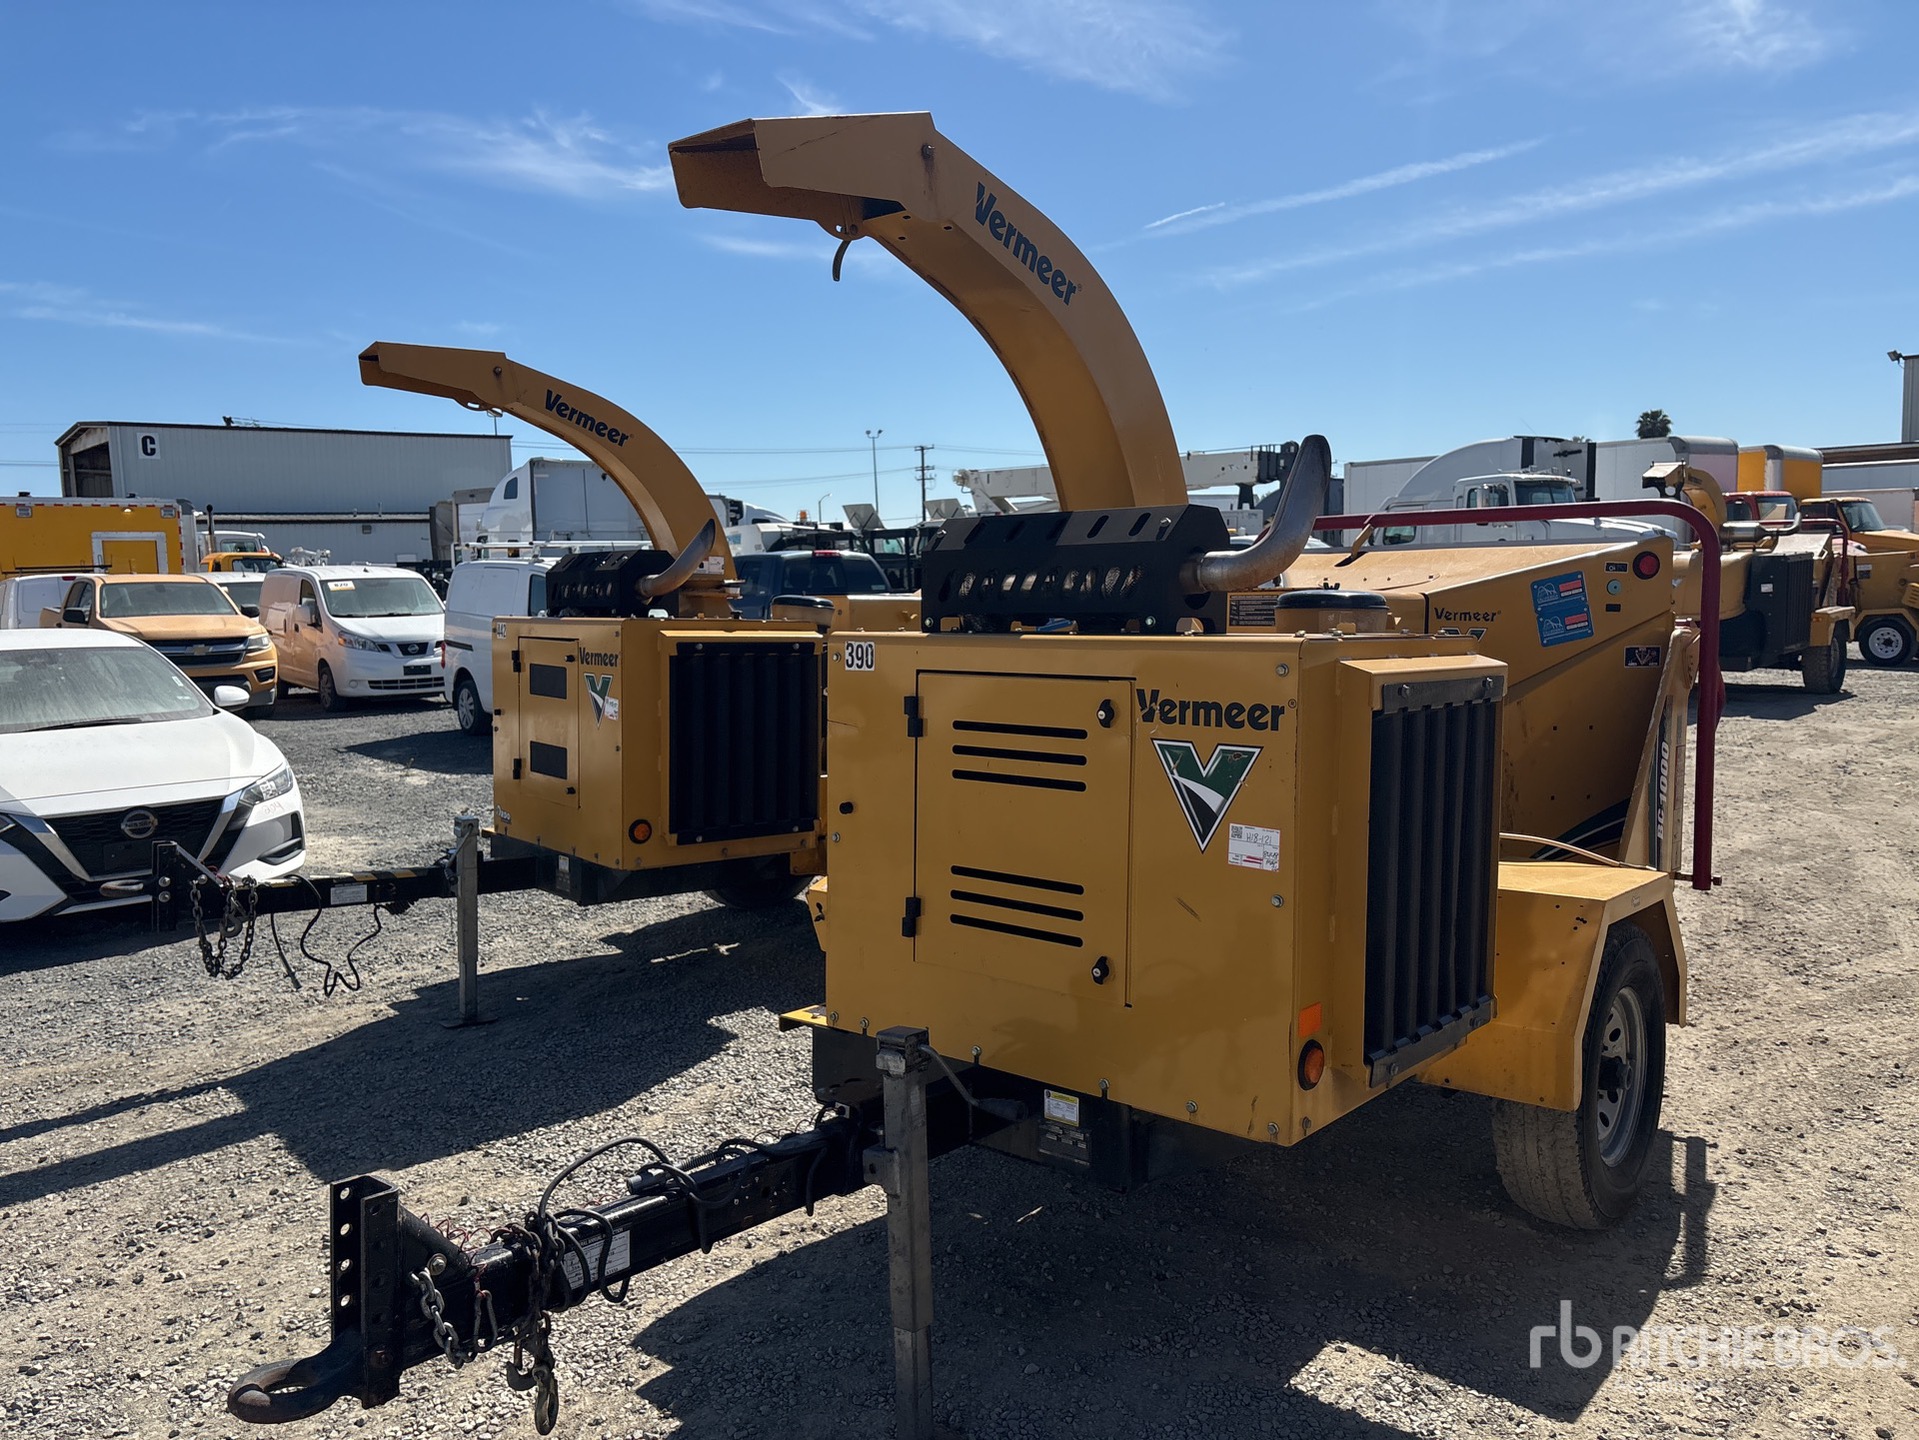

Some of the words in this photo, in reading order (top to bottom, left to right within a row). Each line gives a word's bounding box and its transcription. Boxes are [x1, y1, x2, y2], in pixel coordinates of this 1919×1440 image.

[975, 181, 1077, 306] Vermeer
[545, 388, 629, 447] Vermeer
[141, 435, 156, 457] C
[1434, 606, 1497, 622] Vermeer
[579, 647, 619, 668] Vermeer
[846, 642, 874, 669] 390
[1136, 688, 1286, 731] Vermeer
